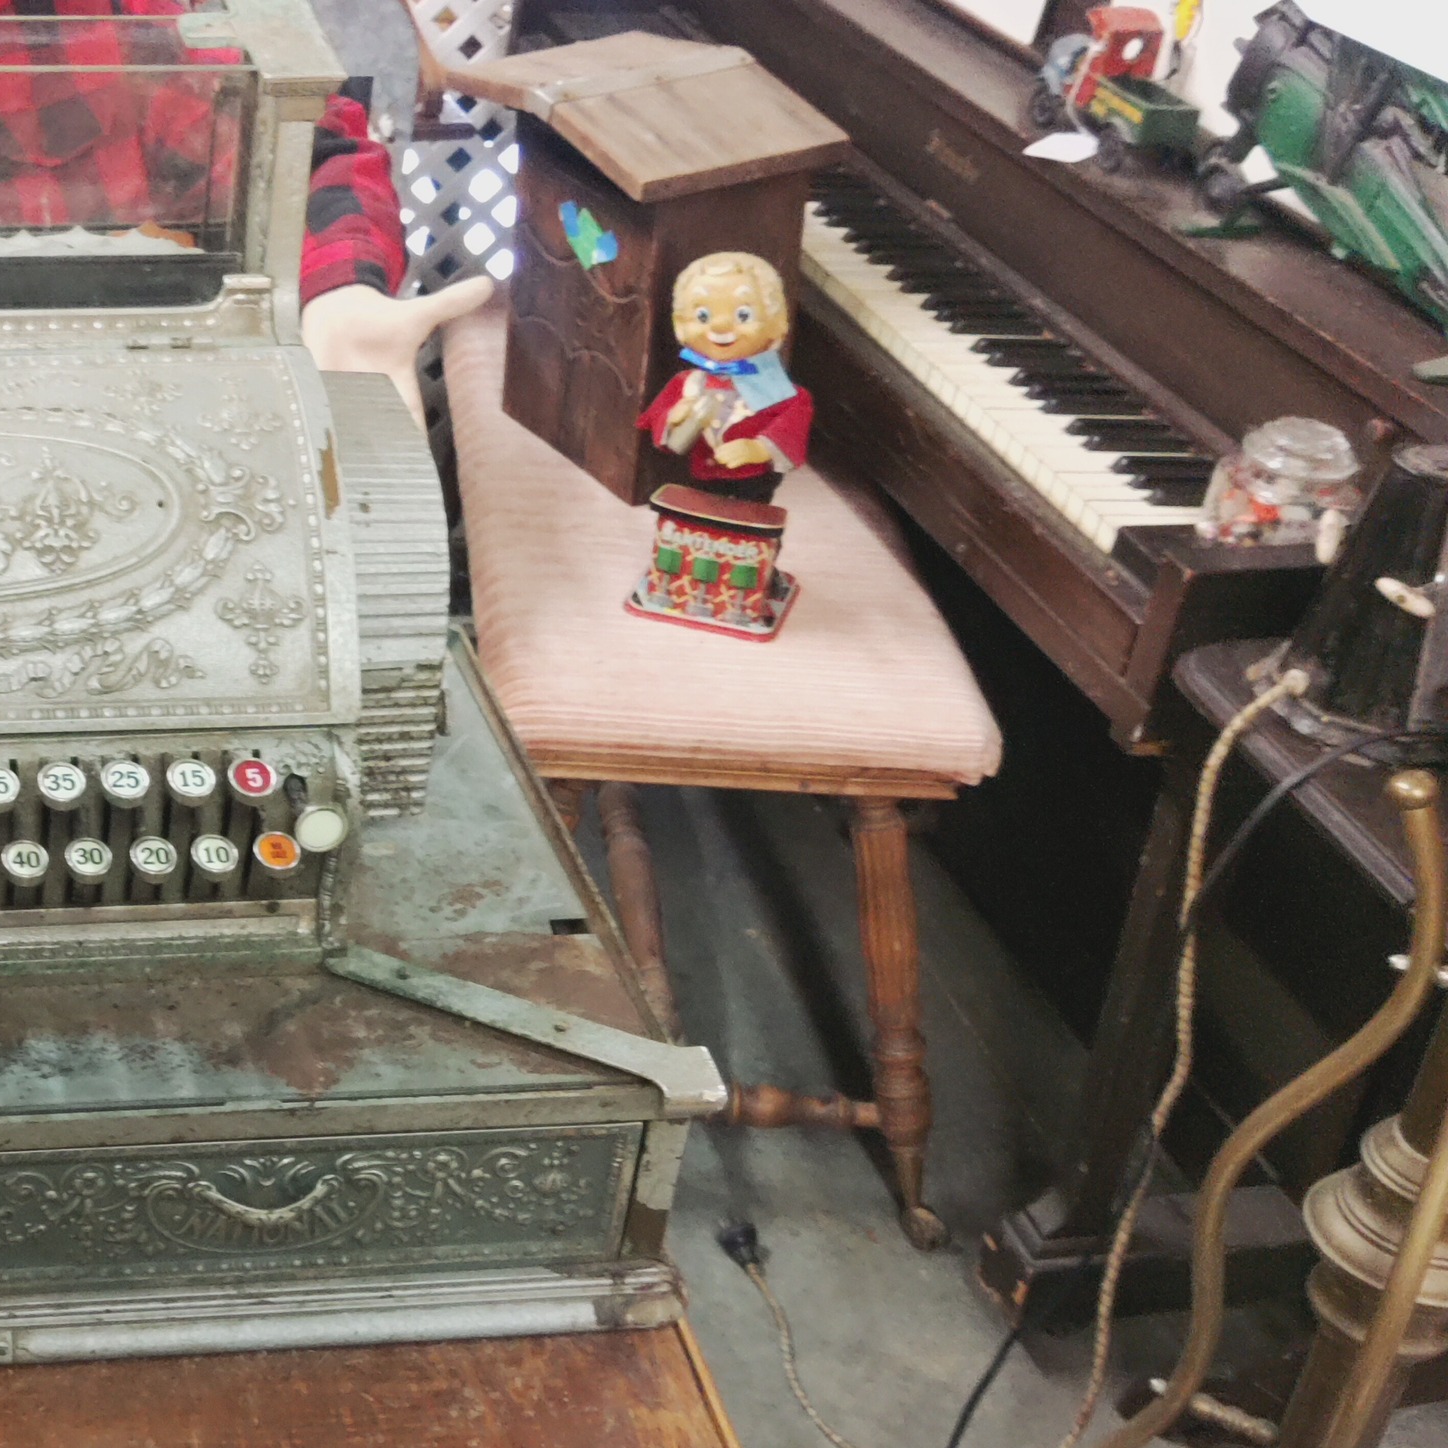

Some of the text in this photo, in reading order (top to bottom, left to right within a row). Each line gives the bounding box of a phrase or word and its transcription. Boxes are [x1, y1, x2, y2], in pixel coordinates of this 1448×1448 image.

[47, 773, 76, 792] 35
[111, 770, 140, 789] 25
[179, 769, 206, 788] 15
[244, 768, 263, 788] 5
[12, 851, 40, 869] 40
[75, 847, 103, 865] 30
[142, 847, 170, 865] 20
[205, 846, 230, 864] 10
